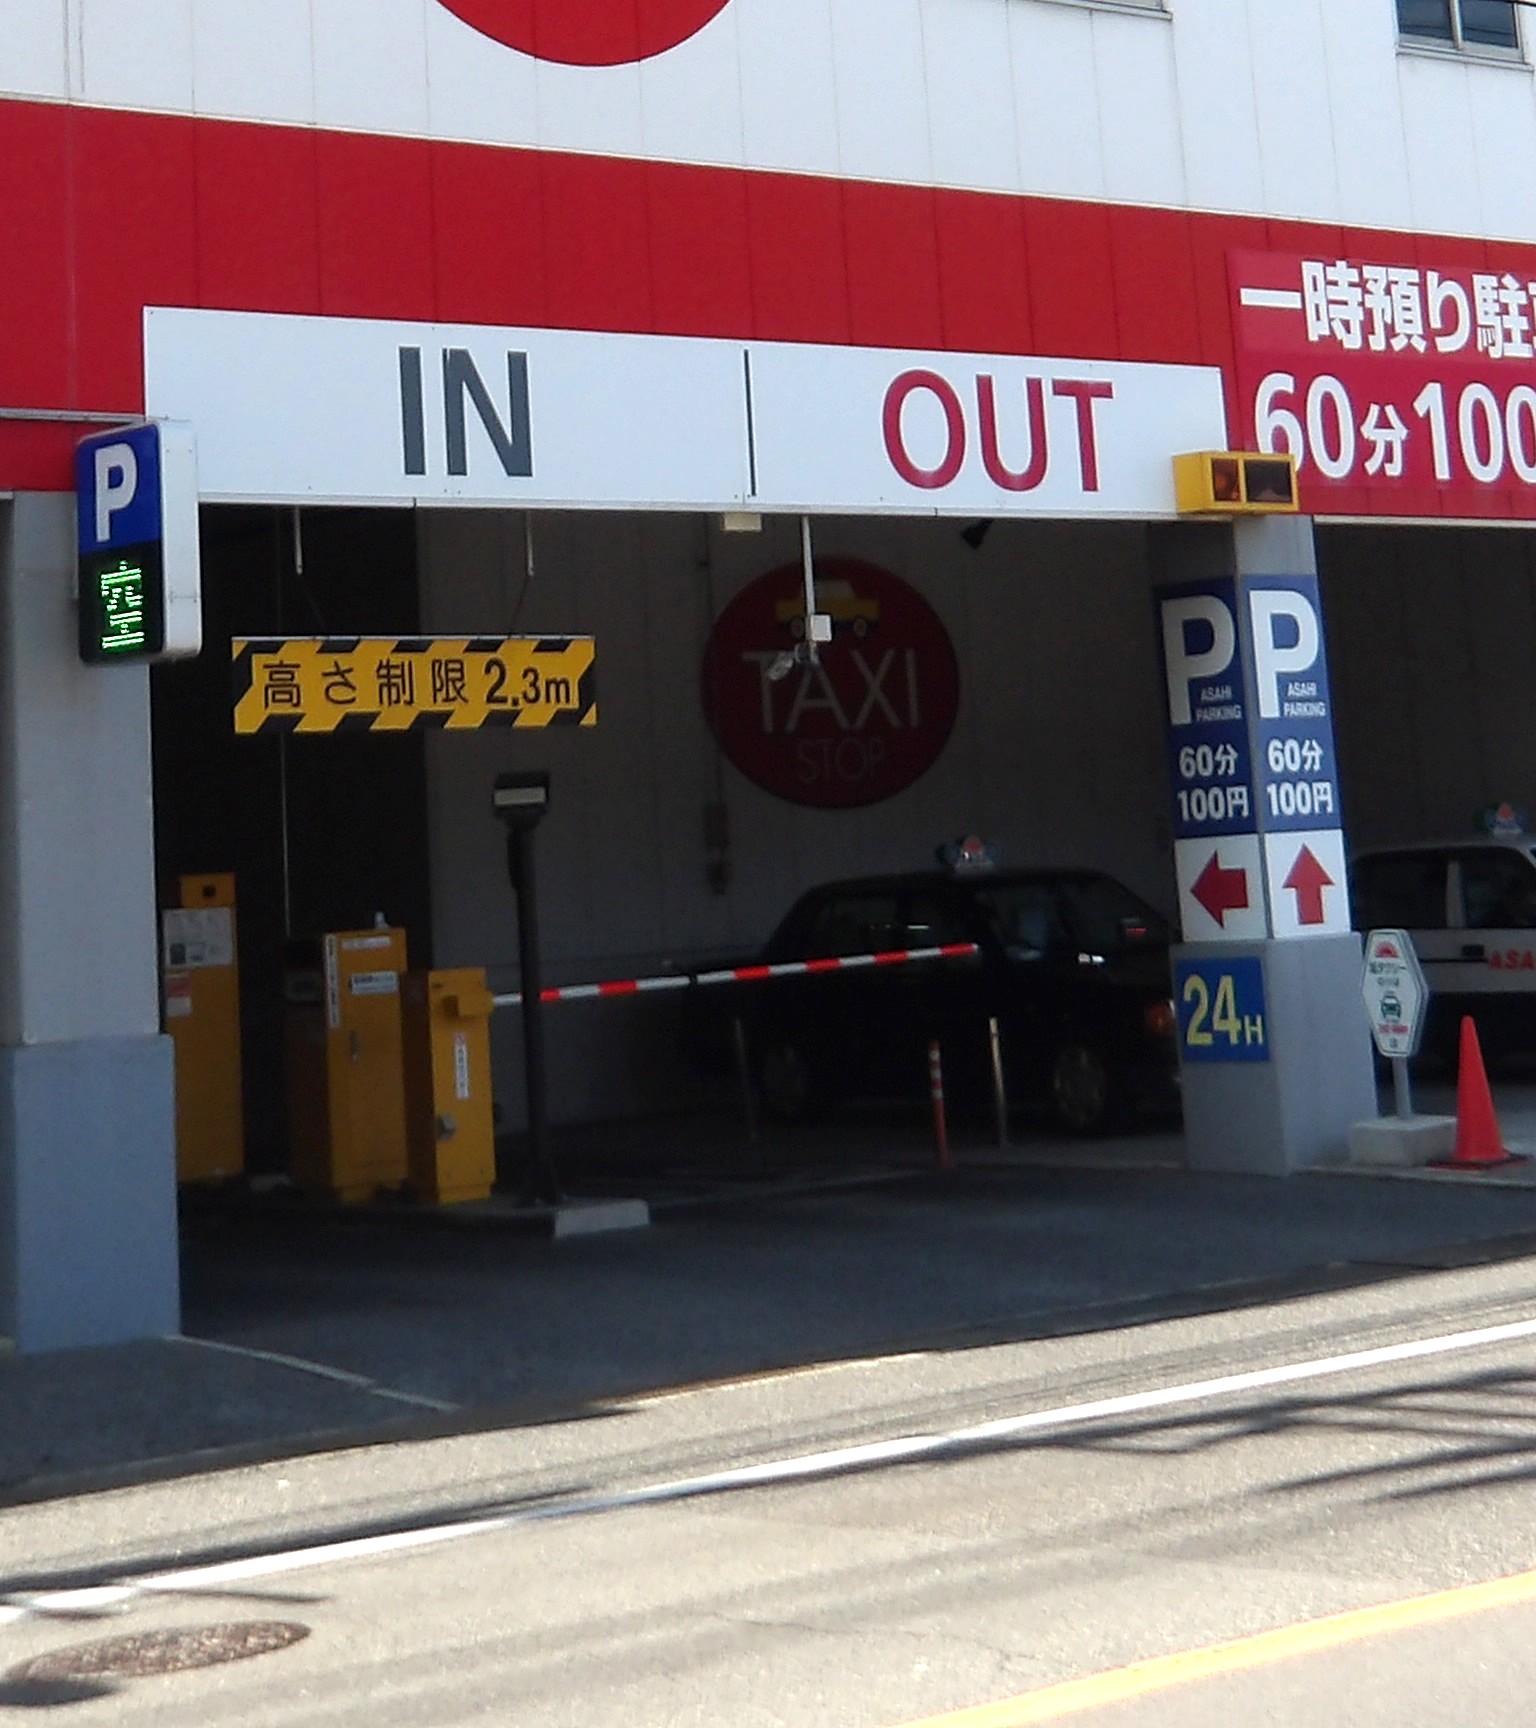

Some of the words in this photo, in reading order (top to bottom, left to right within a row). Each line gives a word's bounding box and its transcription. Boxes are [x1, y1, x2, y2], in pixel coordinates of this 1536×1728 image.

[397, 345, 535, 478] IN
[880, 368, 1115, 493] OUT
[94, 442, 138, 543] P
[1161, 594, 1237, 726] P
[1249, 589, 1320, 719] P
[262, 657, 573, 709] 高さ制限2.3m
[741, 645, 922, 734] TAXI
[1200, 685, 1233, 702] ASAHI
[1287, 682, 1317, 697] ASAHI
[1196, 705, 1243, 722] PARKING
[1283, 701, 1326, 718] PARKING
[796, 737, 885, 785] STOP
[1178, 743, 1239, 779] 60分
[1267, 738, 1324, 774] 60分
[1177, 784, 1250, 823] 100円
[1266, 781, 1334, 818] 100円
[1181, 972, 1264, 1048] 24H
